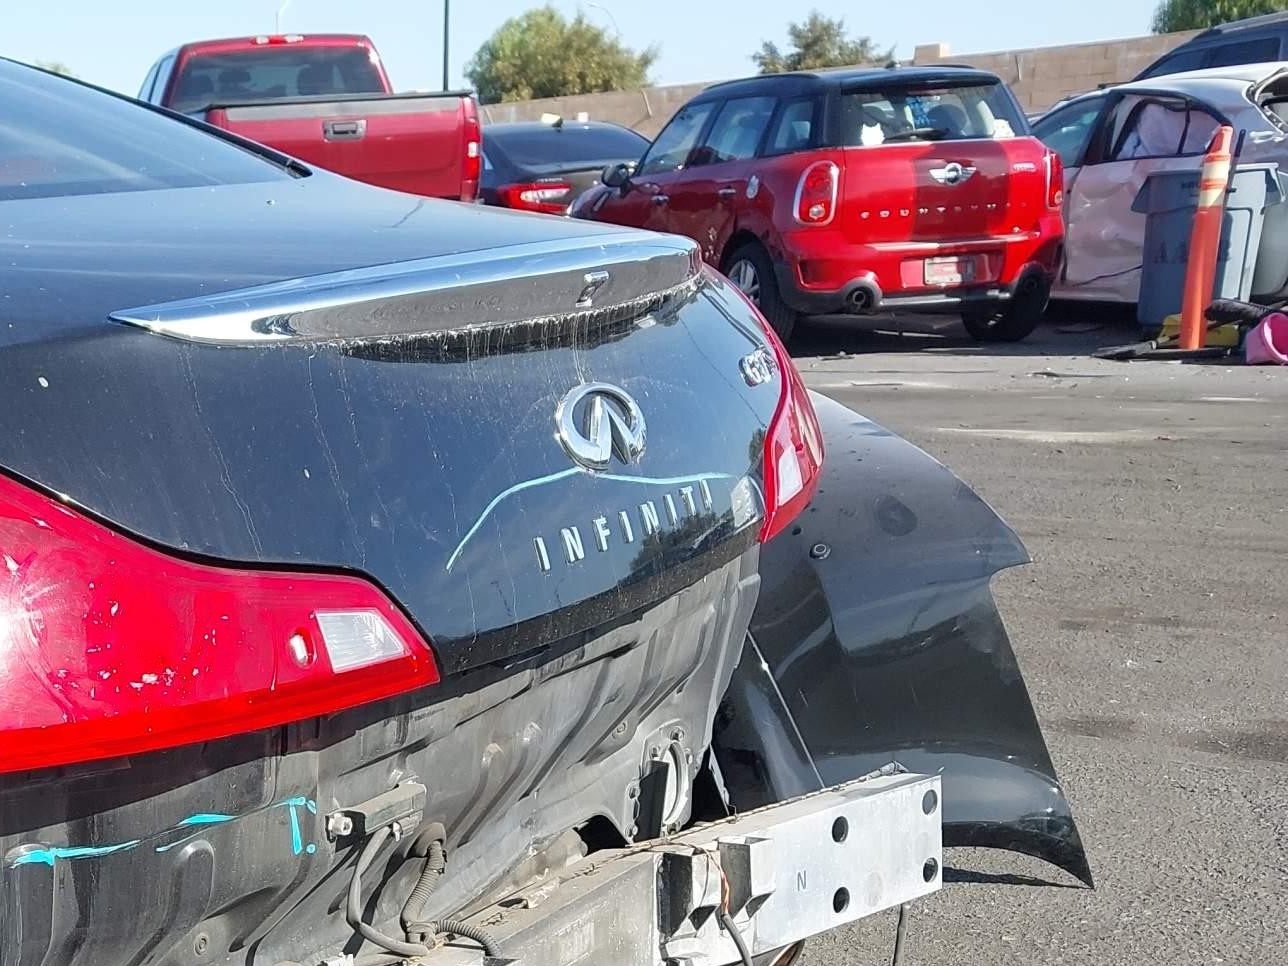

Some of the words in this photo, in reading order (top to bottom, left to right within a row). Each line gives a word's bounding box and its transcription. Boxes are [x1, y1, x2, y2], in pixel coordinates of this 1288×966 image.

[859, 202, 1028, 220] COUNTM
[532, 479, 713, 572] INFINITI
[797, 870, 807, 891] N
